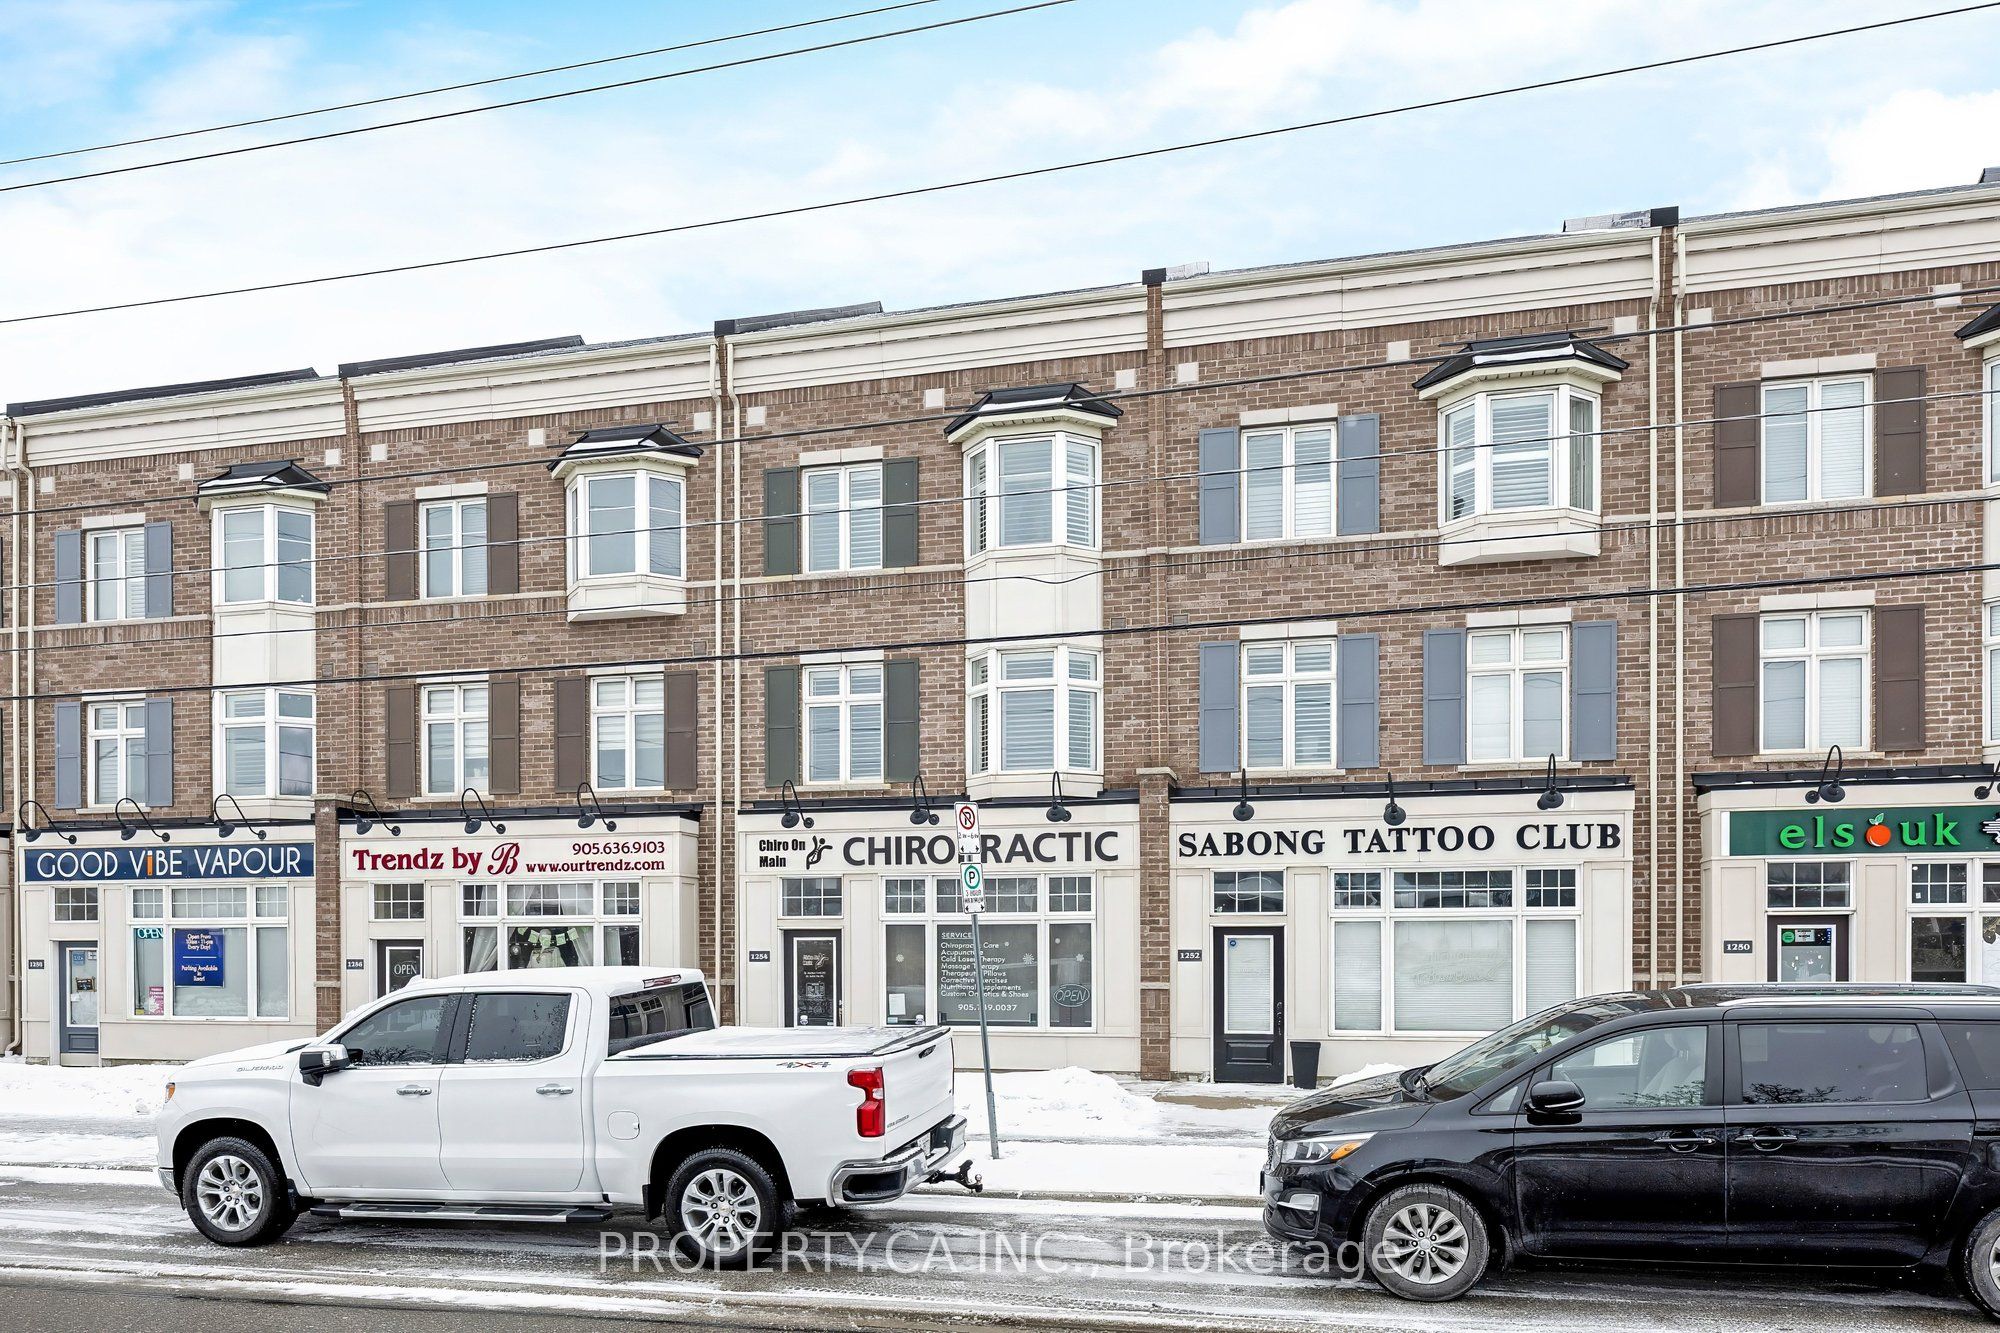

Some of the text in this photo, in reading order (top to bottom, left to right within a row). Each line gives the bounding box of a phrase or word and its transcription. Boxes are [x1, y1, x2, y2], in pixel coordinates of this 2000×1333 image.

[759, 838, 806, 851] Chiro On
[1178, 822, 1621, 857] SABONG TATTOO CLUB
[572, 841, 665, 856] 905.636.9103
[843, 831, 1118, 866] CHIRORACTIC
[37, 851, 118, 878] GOOD
[194, 847, 301, 876] VAPOUR
[352, 842, 520, 875] Trendz by B
[759, 855, 787, 868] Main
[526, 858, 665, 873] www.ourtrendz.com
[137, 928, 163, 939] OPEN
[941, 942, 981, 950] Chiroprac
[1726, 943, 1750, 951] 1250
[941, 949, 984, 957] Acupuncte
[394, 963, 417, 975] OPEN
[972, 963, 1000, 971] Terapy
[1055, 989, 1087, 1002] OPEN
